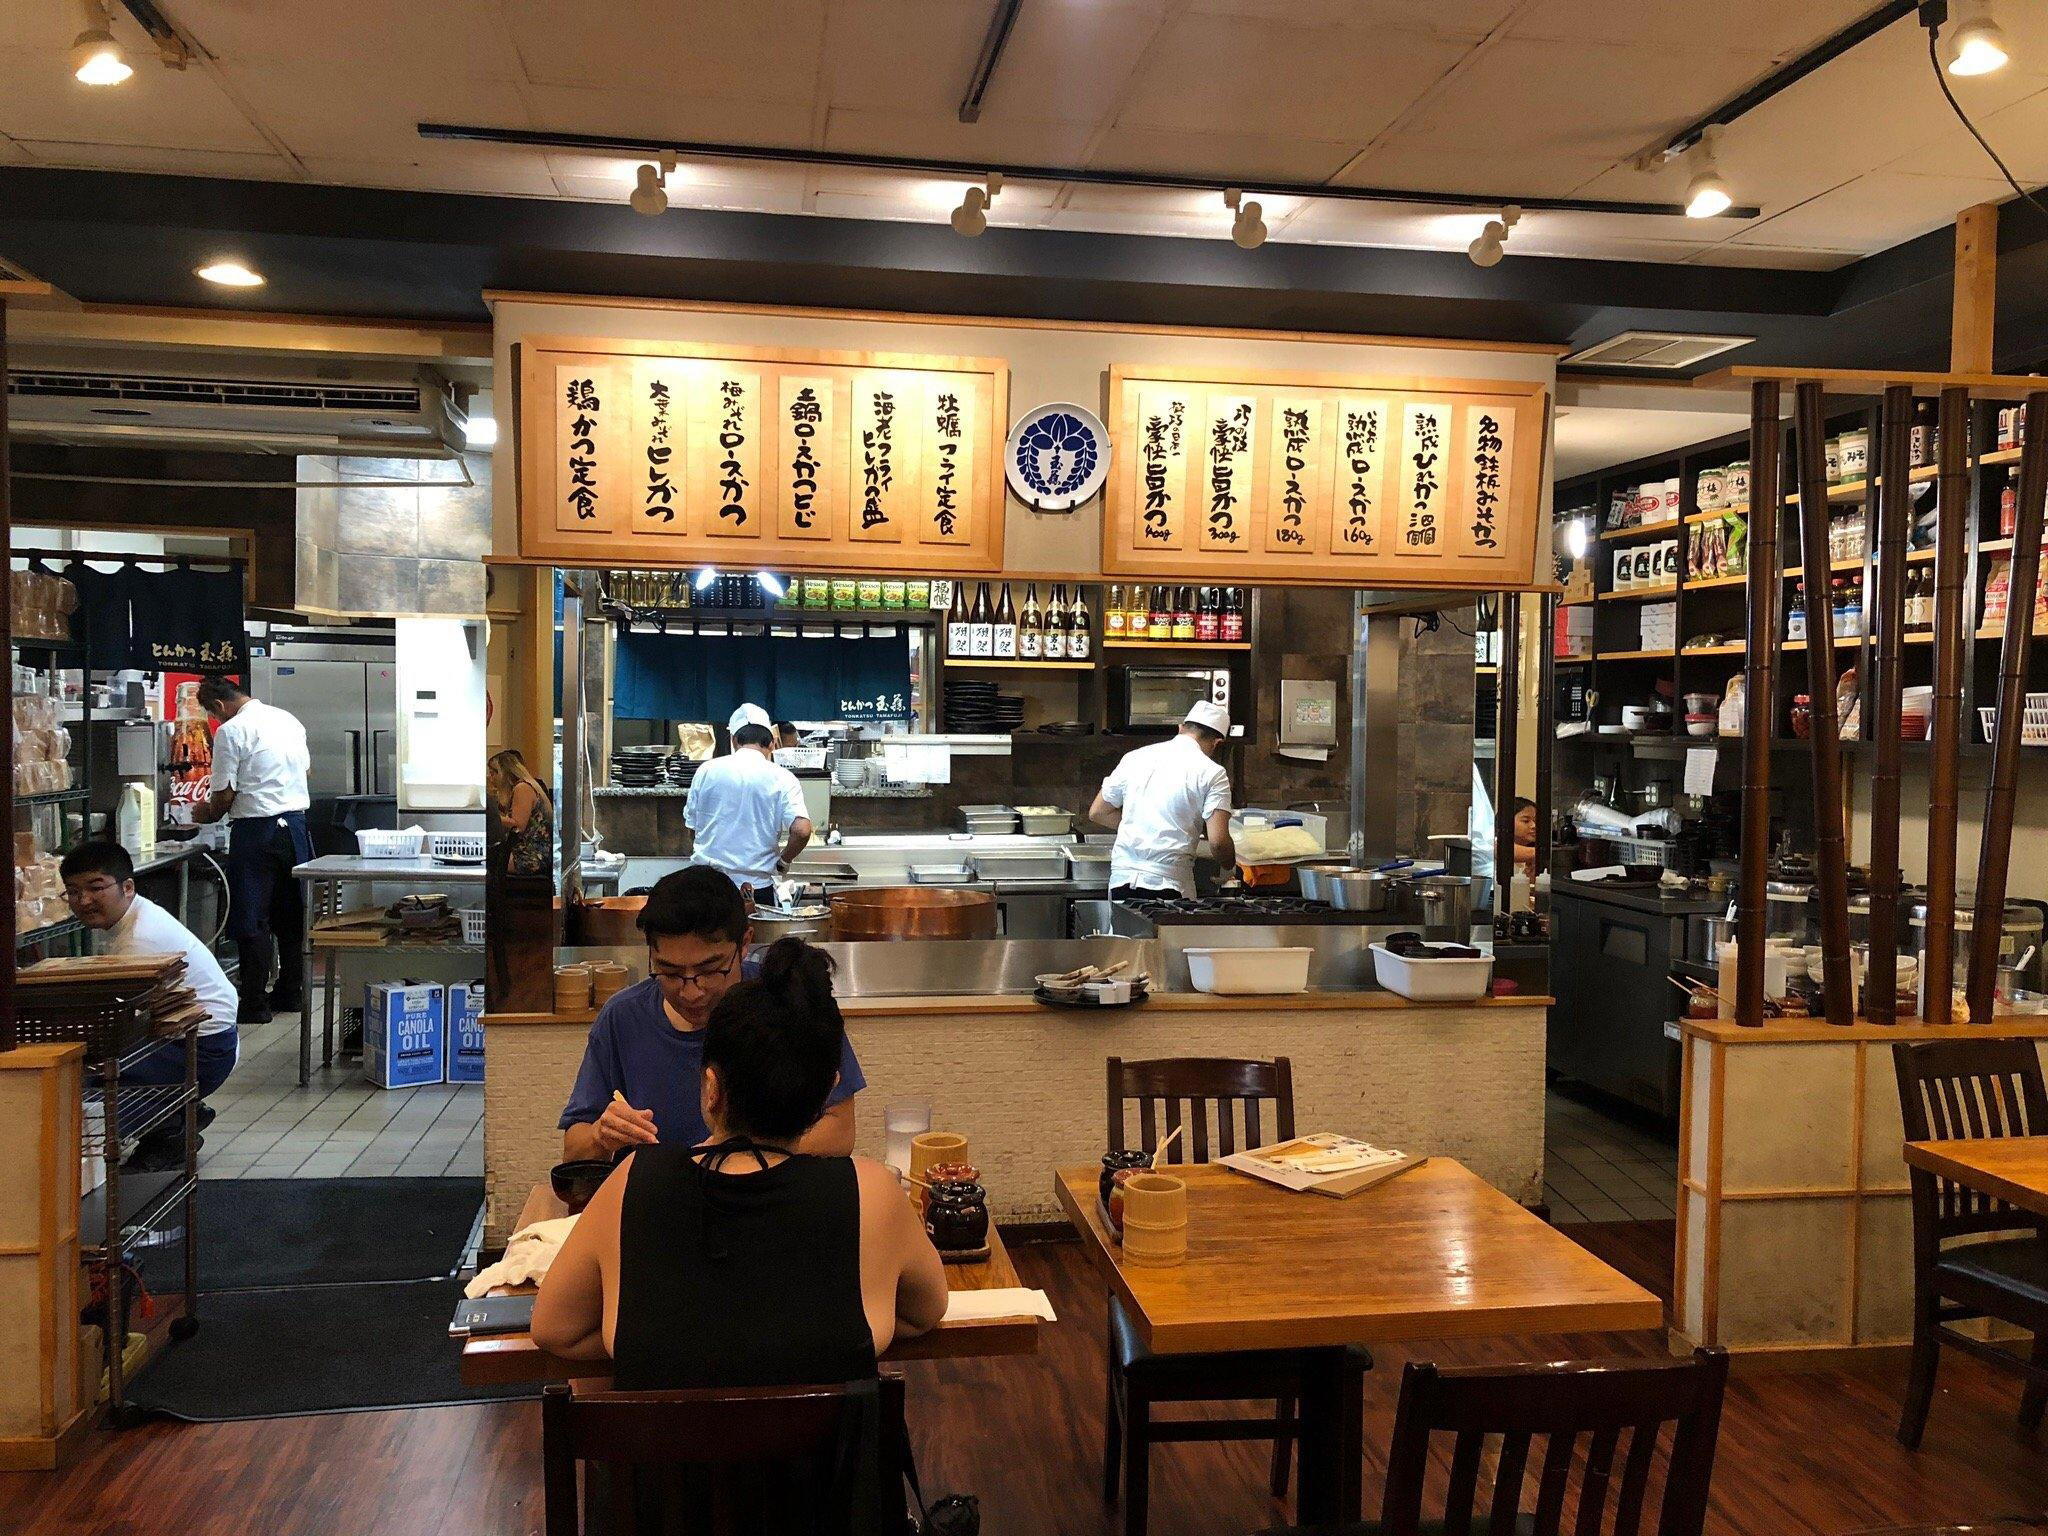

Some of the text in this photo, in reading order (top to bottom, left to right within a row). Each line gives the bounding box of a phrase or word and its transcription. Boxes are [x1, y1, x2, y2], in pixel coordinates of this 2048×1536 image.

[566, 378, 600, 520] 鶏かつ定食
[1343, 526, 1374, 546] 160g
[152, 642, 196, 658] とんかつ
[841, 699, 874, 712] とんかつ
[398, 1018, 434, 1036] CANOLA
[402, 1034, 431, 1051] OIL
